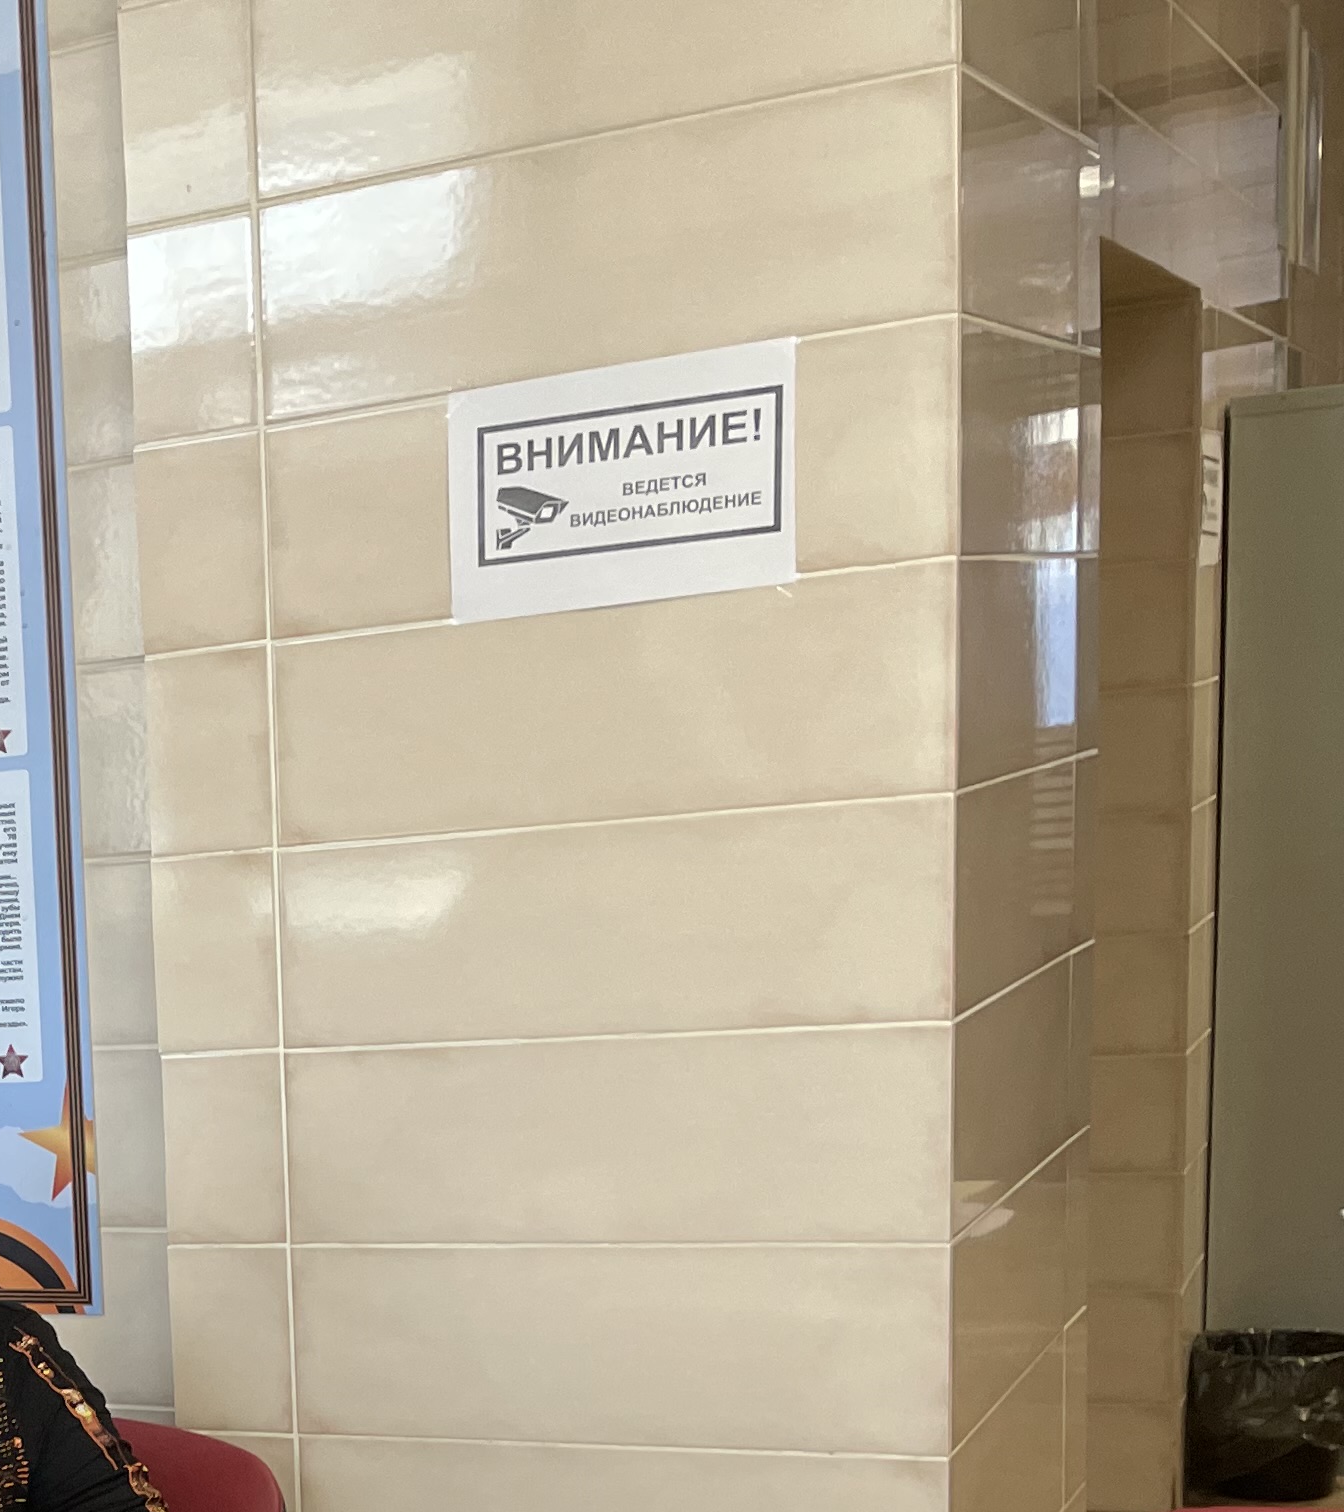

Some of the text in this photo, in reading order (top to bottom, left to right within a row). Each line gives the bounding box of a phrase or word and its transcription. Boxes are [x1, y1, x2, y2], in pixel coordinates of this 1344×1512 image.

[496, 407, 762, 475] ВНИМАНИЕ!
[621, 472, 707, 496] ВЕДЕТСЯ
[570, 490, 762, 528] ВИДЕОНАБЛЮДЕНИЕ
